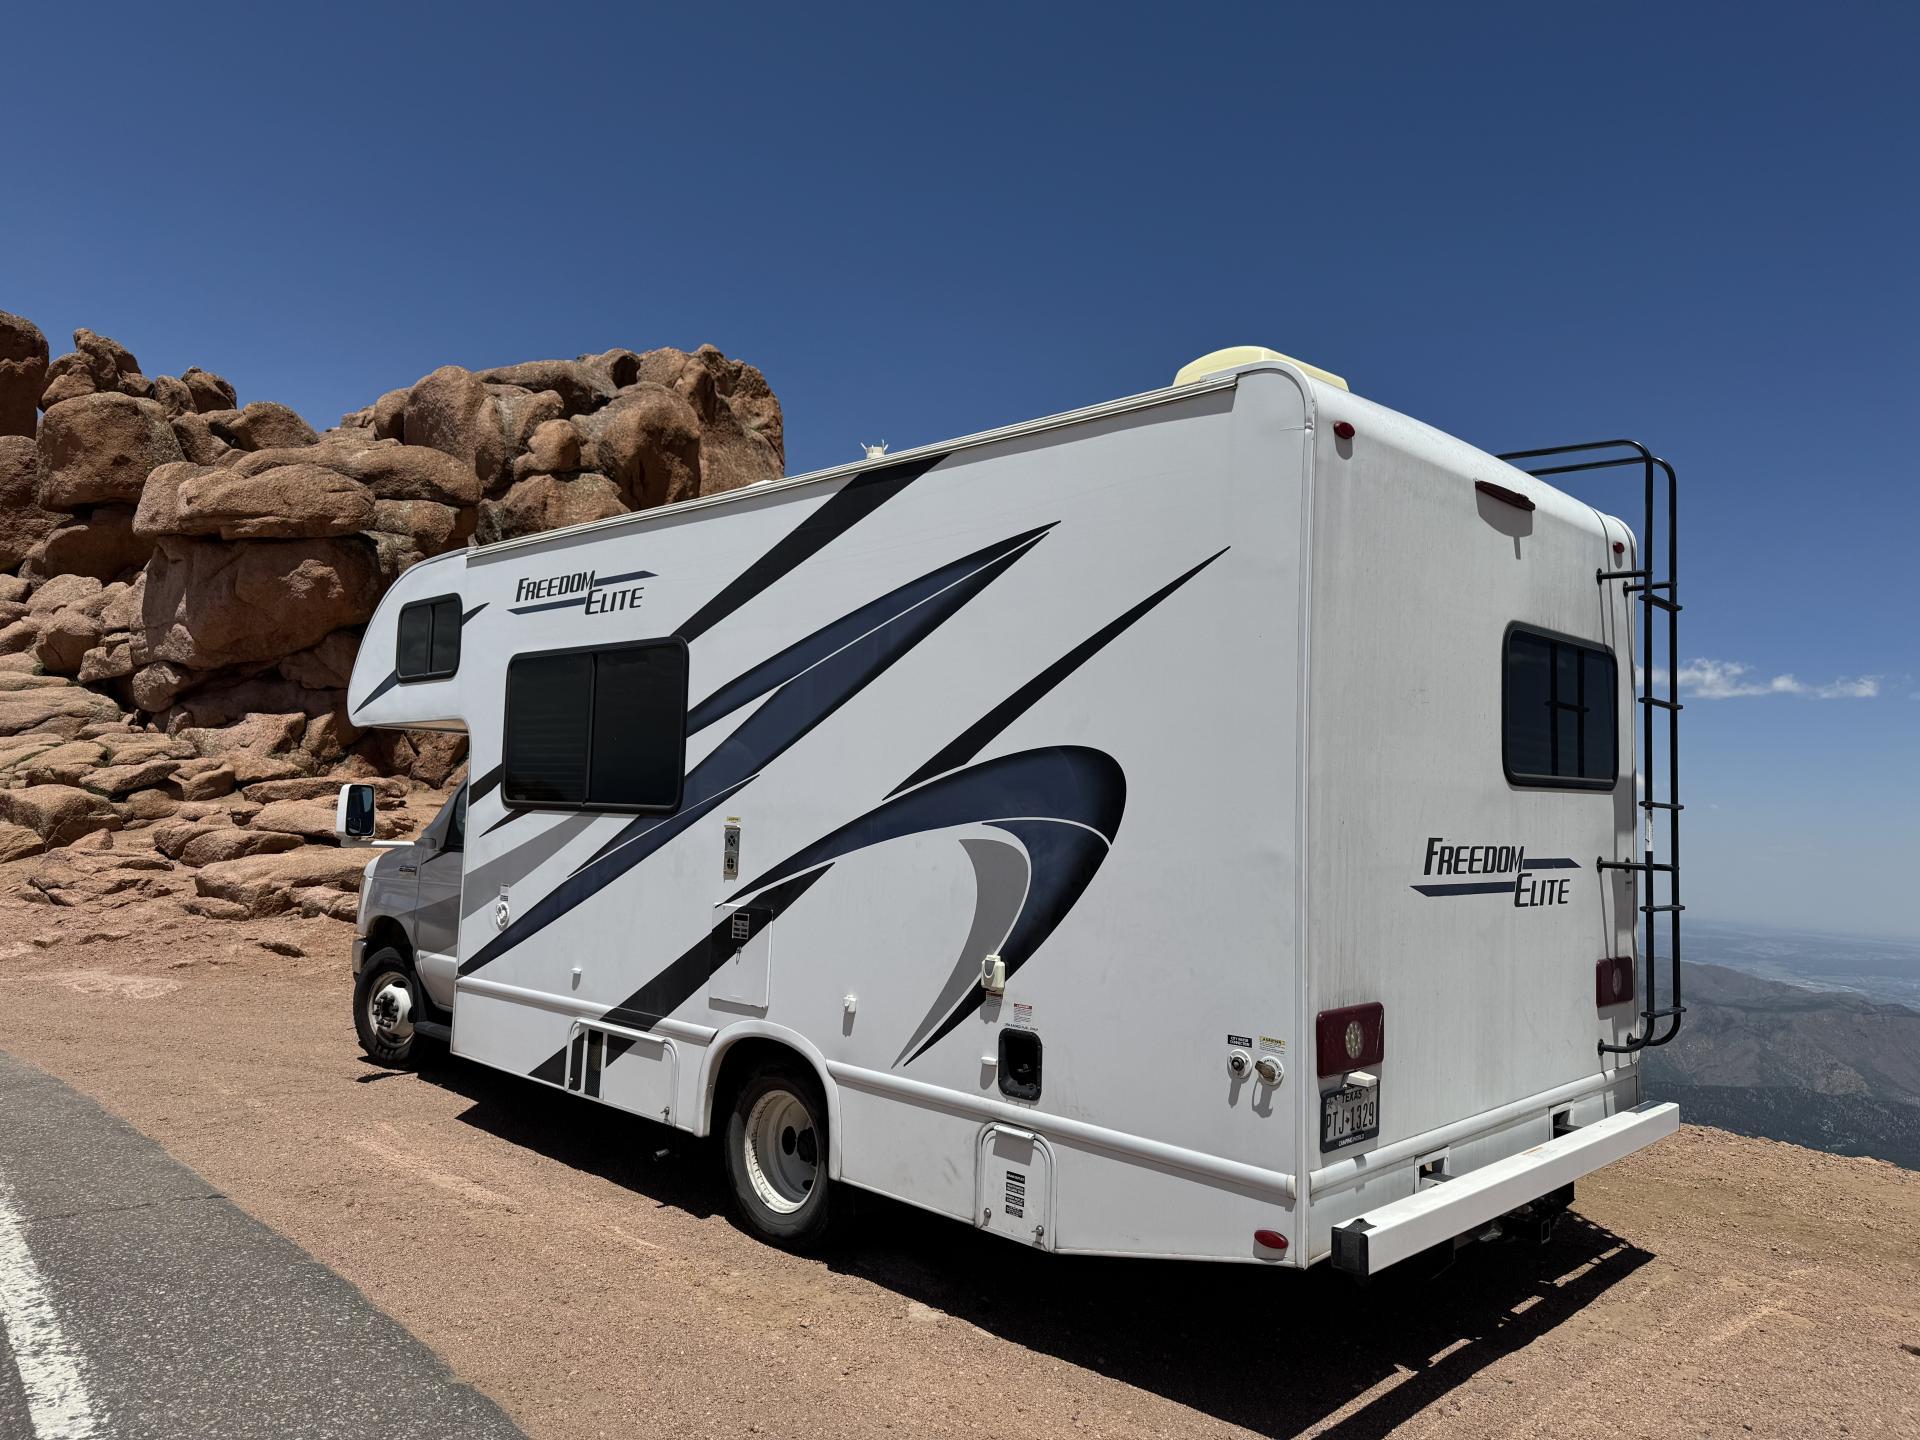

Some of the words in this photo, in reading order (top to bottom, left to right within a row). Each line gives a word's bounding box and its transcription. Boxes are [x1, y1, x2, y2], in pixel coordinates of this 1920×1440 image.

[515, 570, 596, 603] FREEDOM
[584, 587, 645, 615] ELITE
[1423, 837, 1525, 876] FREEDOM
[1513, 873, 1571, 908] ELITE
[1341, 1088, 1363, 1104] TEXAS
